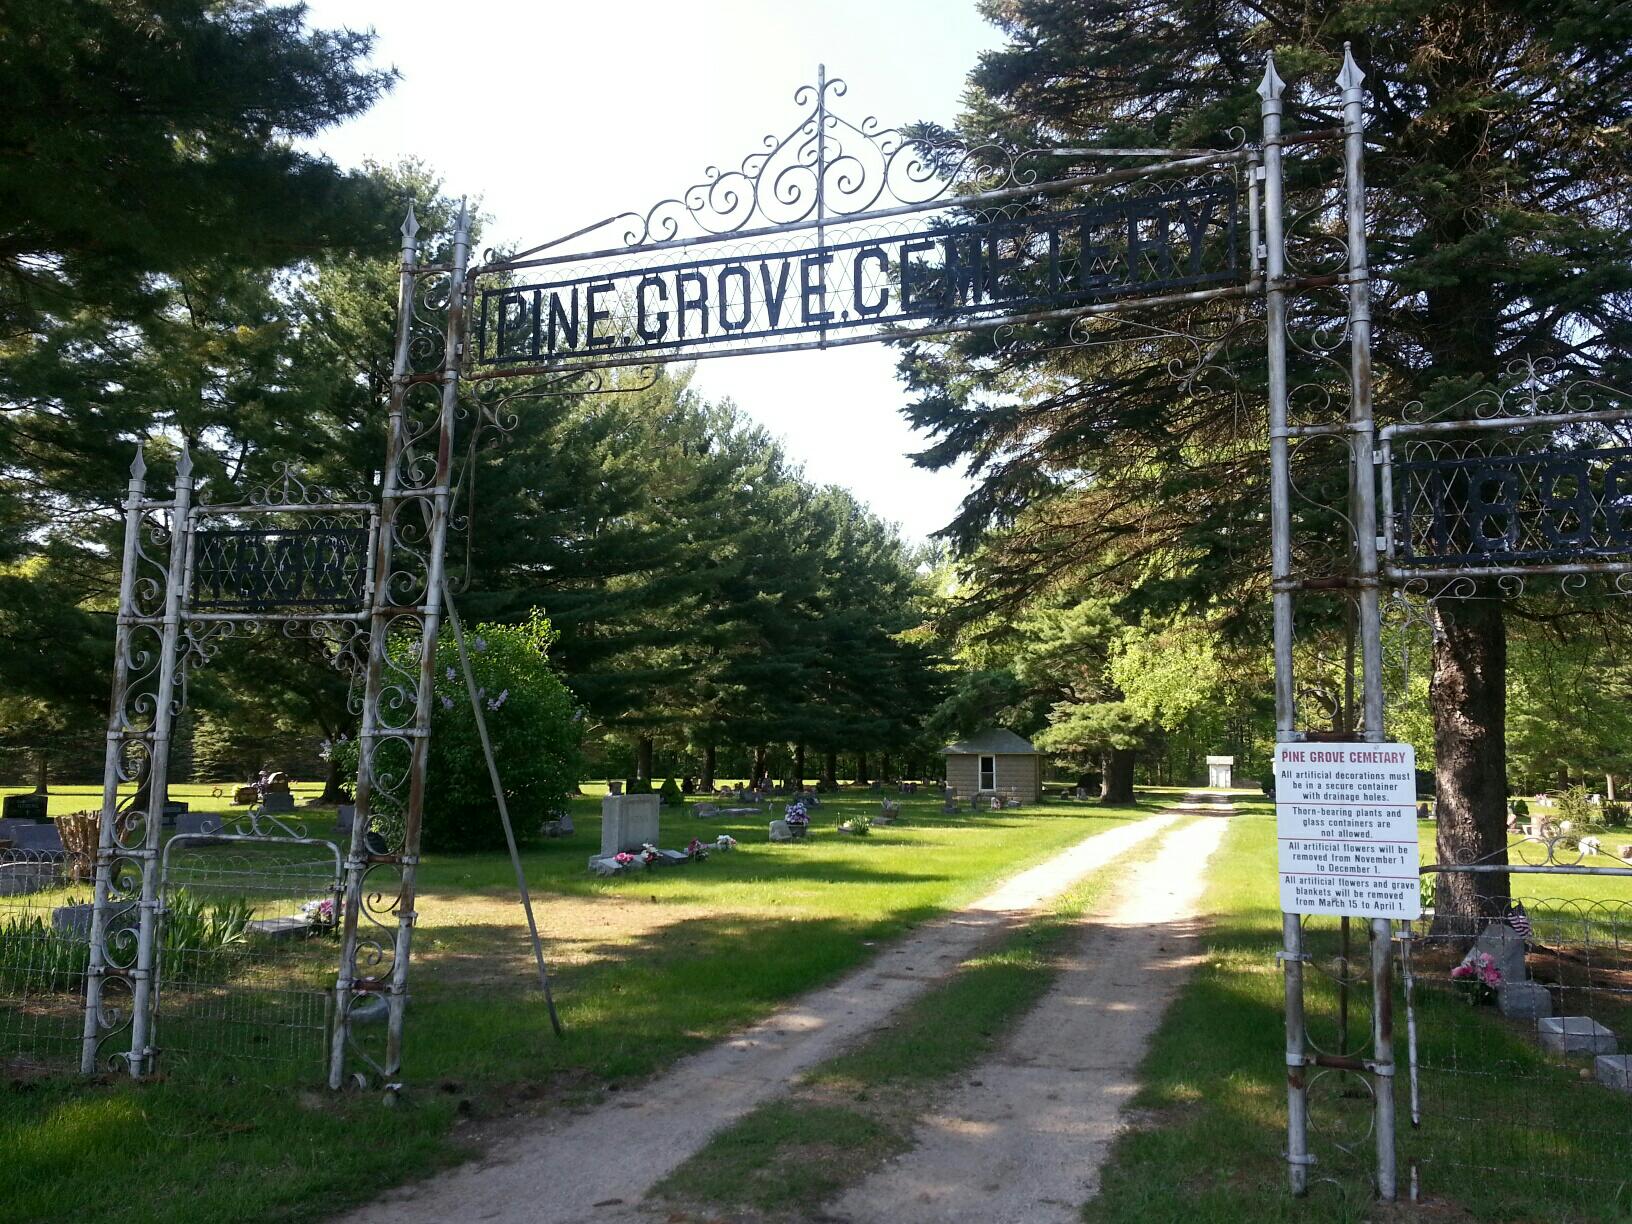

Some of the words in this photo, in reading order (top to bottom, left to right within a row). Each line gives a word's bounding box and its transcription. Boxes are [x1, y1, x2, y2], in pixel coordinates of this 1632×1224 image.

[1282, 751, 1306, 763] PINE
[1310, 752, 1345, 763] GROVE
[1350, 752, 1406, 764] CEMETARY
[1281, 771, 1292, 779] All
[1296, 771, 1332, 779] artificial
[1335, 772, 1385, 780] decorations
[1293, 781, 1303, 789] be
[1357, 783, 1398, 791] container
[1303, 792, 1321, 800] with
[1323, 793, 1360, 801] drainage
[1363, 793, 1389, 801] holes.
[1293, 807, 1352, 817] Thorn-bearing
[1356, 809, 1383, 818] plants
[1386, 810, 1401, 818] and
[1303, 819, 1325, 827] glass
[1328, 819, 1373, 828] containers
[1338, 830, 1373, 839] allowed.
[1303, 843, 1340, 851] artificial
[1343, 844, 1375, 853] flowers
[1379, 845, 1394, 854] will
[1398, 846, 1408, 854] be
[1293, 853, 1328, 862] removed
[1331, 854, 1351, 863] from
[1355, 854, 1397, 864] November
[1401, 856, 1404, 864] 1
[1317, 864, 1325, 872] to
[1328, 864, 1370, 874] December
[1374, 866, 1381, 874] 1.
[1285, 876, 1296, 884] All
[1299, 877, 1335, 885] artificial
[1339, 878, 1369, 887] flowers
[1373, 879, 1388, 888] and
[1392, 881, 1415, 890] grave
[1296, 887, 1331, 896] blankets
[1335, 888, 1350, 897] will
[1354, 889, 1364, 898] be
[1368, 890, 1404, 900] removed
[1296, 898, 1315, 906] from
[1319, 898, 1345, 908] March
[1348, 900, 1358, 908] 15
[1361, 900, 1370, 909] to
[1374, 901, 1395, 911] April
[1398, 903, 1405, 911] 1.
